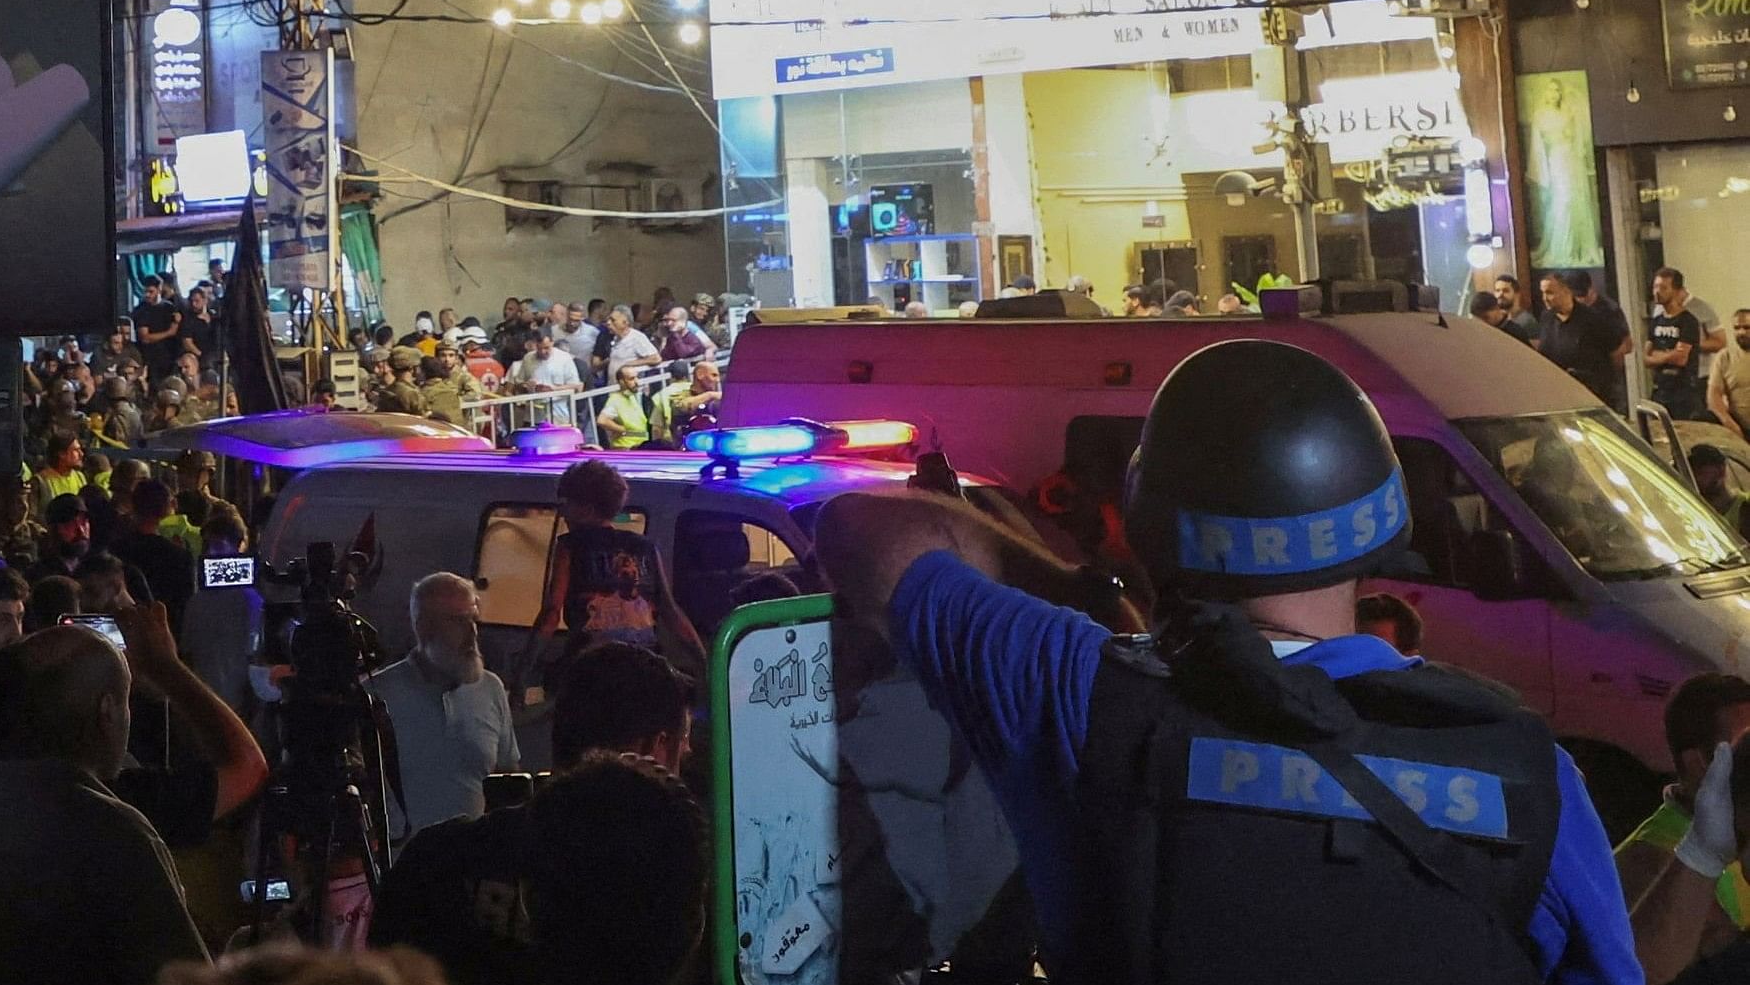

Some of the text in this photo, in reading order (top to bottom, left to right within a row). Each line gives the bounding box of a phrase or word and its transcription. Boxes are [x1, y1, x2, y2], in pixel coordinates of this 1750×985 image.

[1113, 17, 1240, 44] MEN & WOMEN
[1199, 483, 1401, 567] PRESS
[1220, 749, 1481, 824] PRSS
